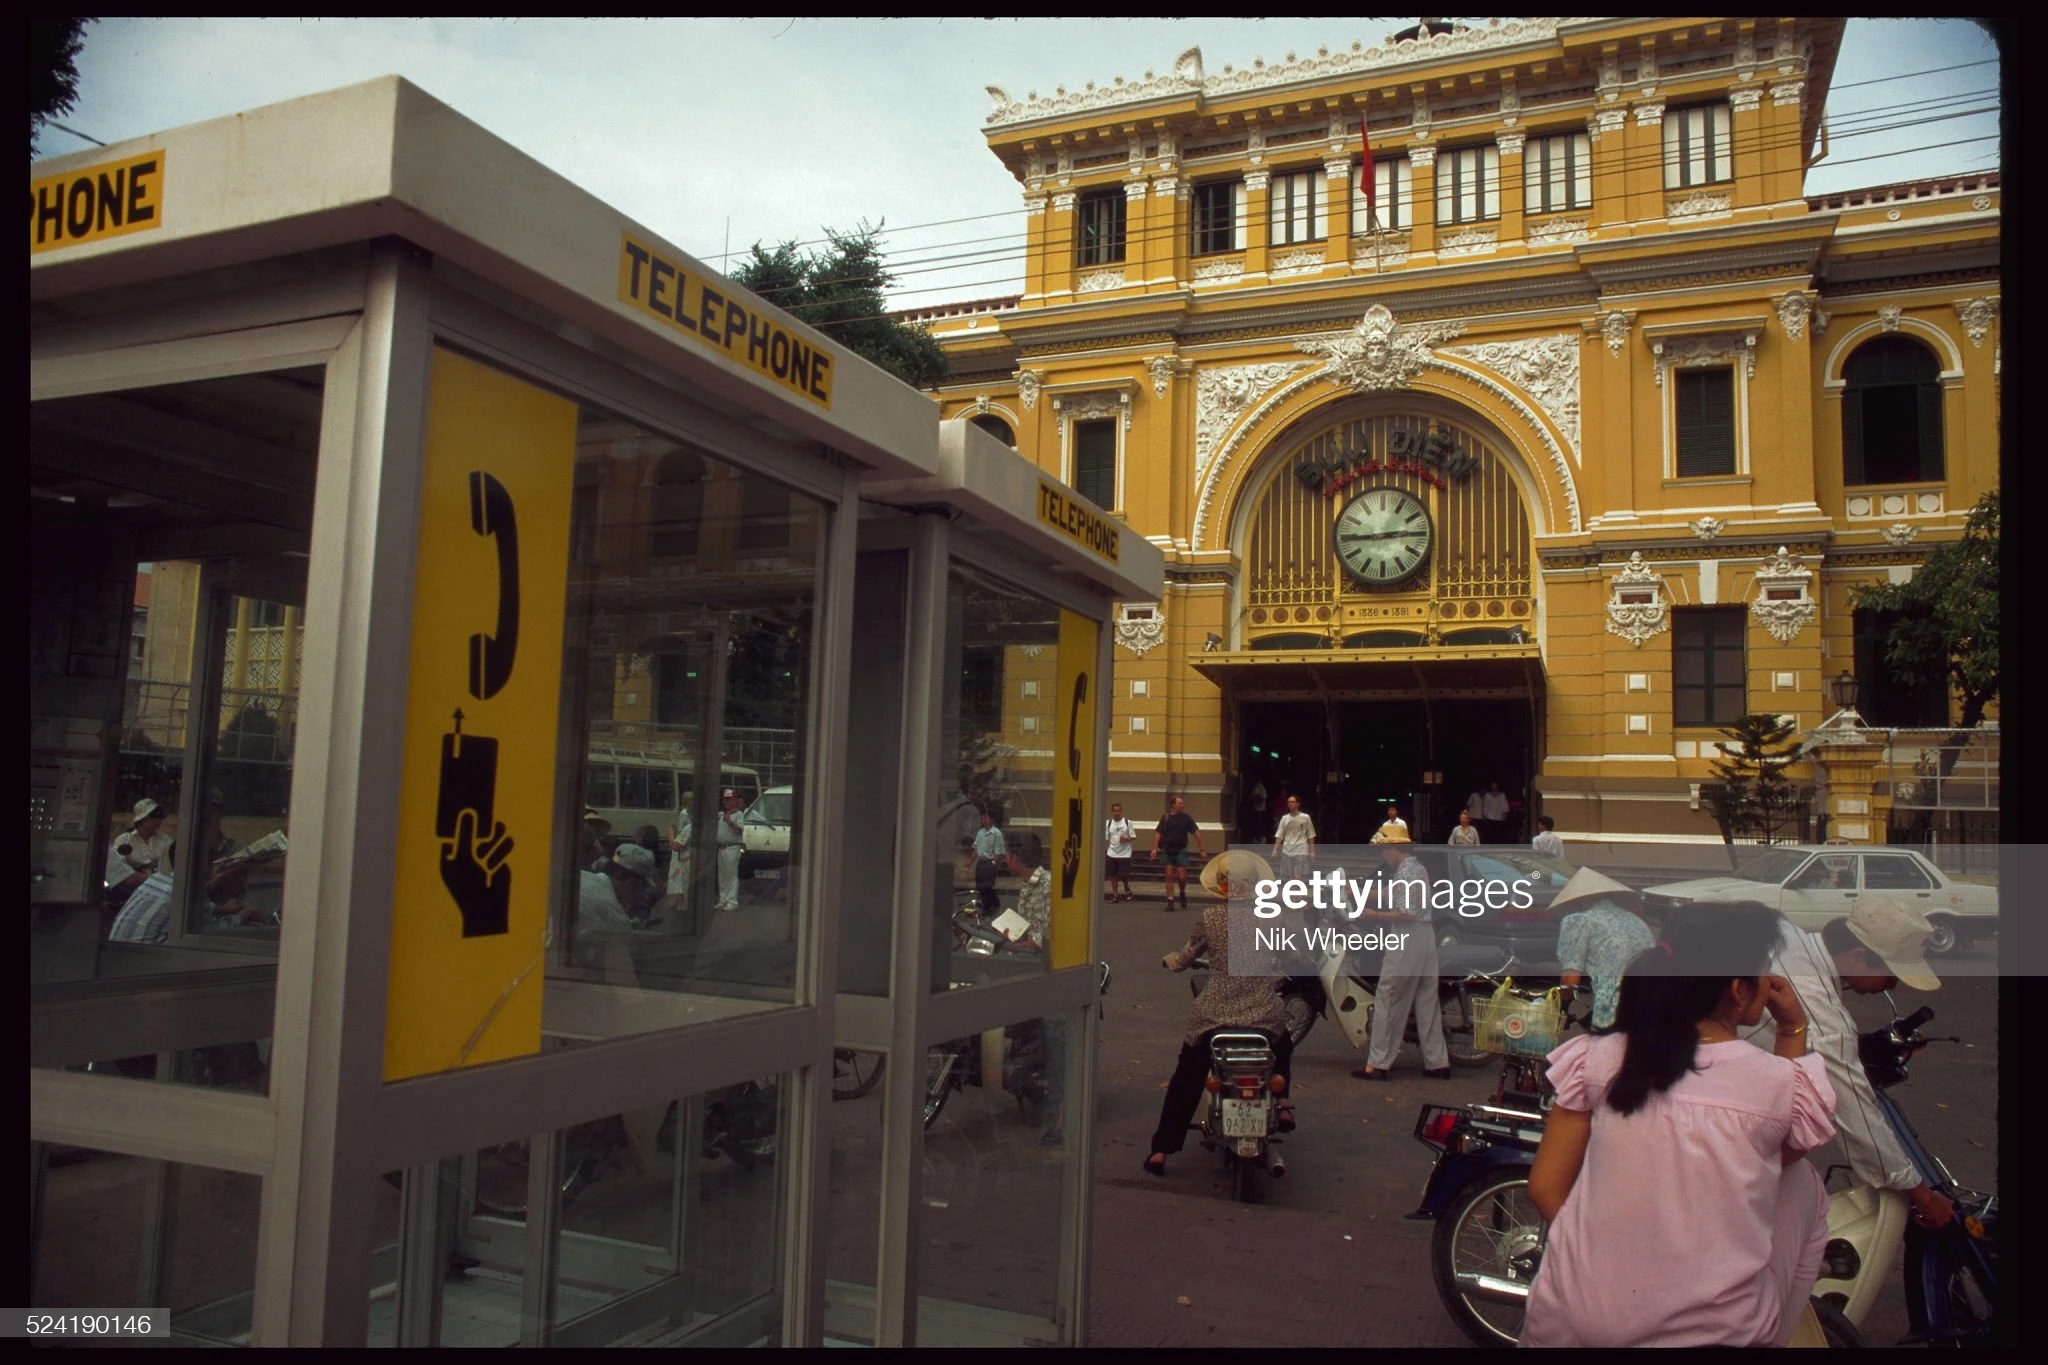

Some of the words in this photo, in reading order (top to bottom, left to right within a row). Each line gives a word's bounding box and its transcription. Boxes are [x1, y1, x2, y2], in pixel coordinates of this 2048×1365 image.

[625, 240, 830, 402] TELEPHONE
[1040, 483, 1119, 560] TELEPHONE
[1391, 607, 1409, 617] 1891
